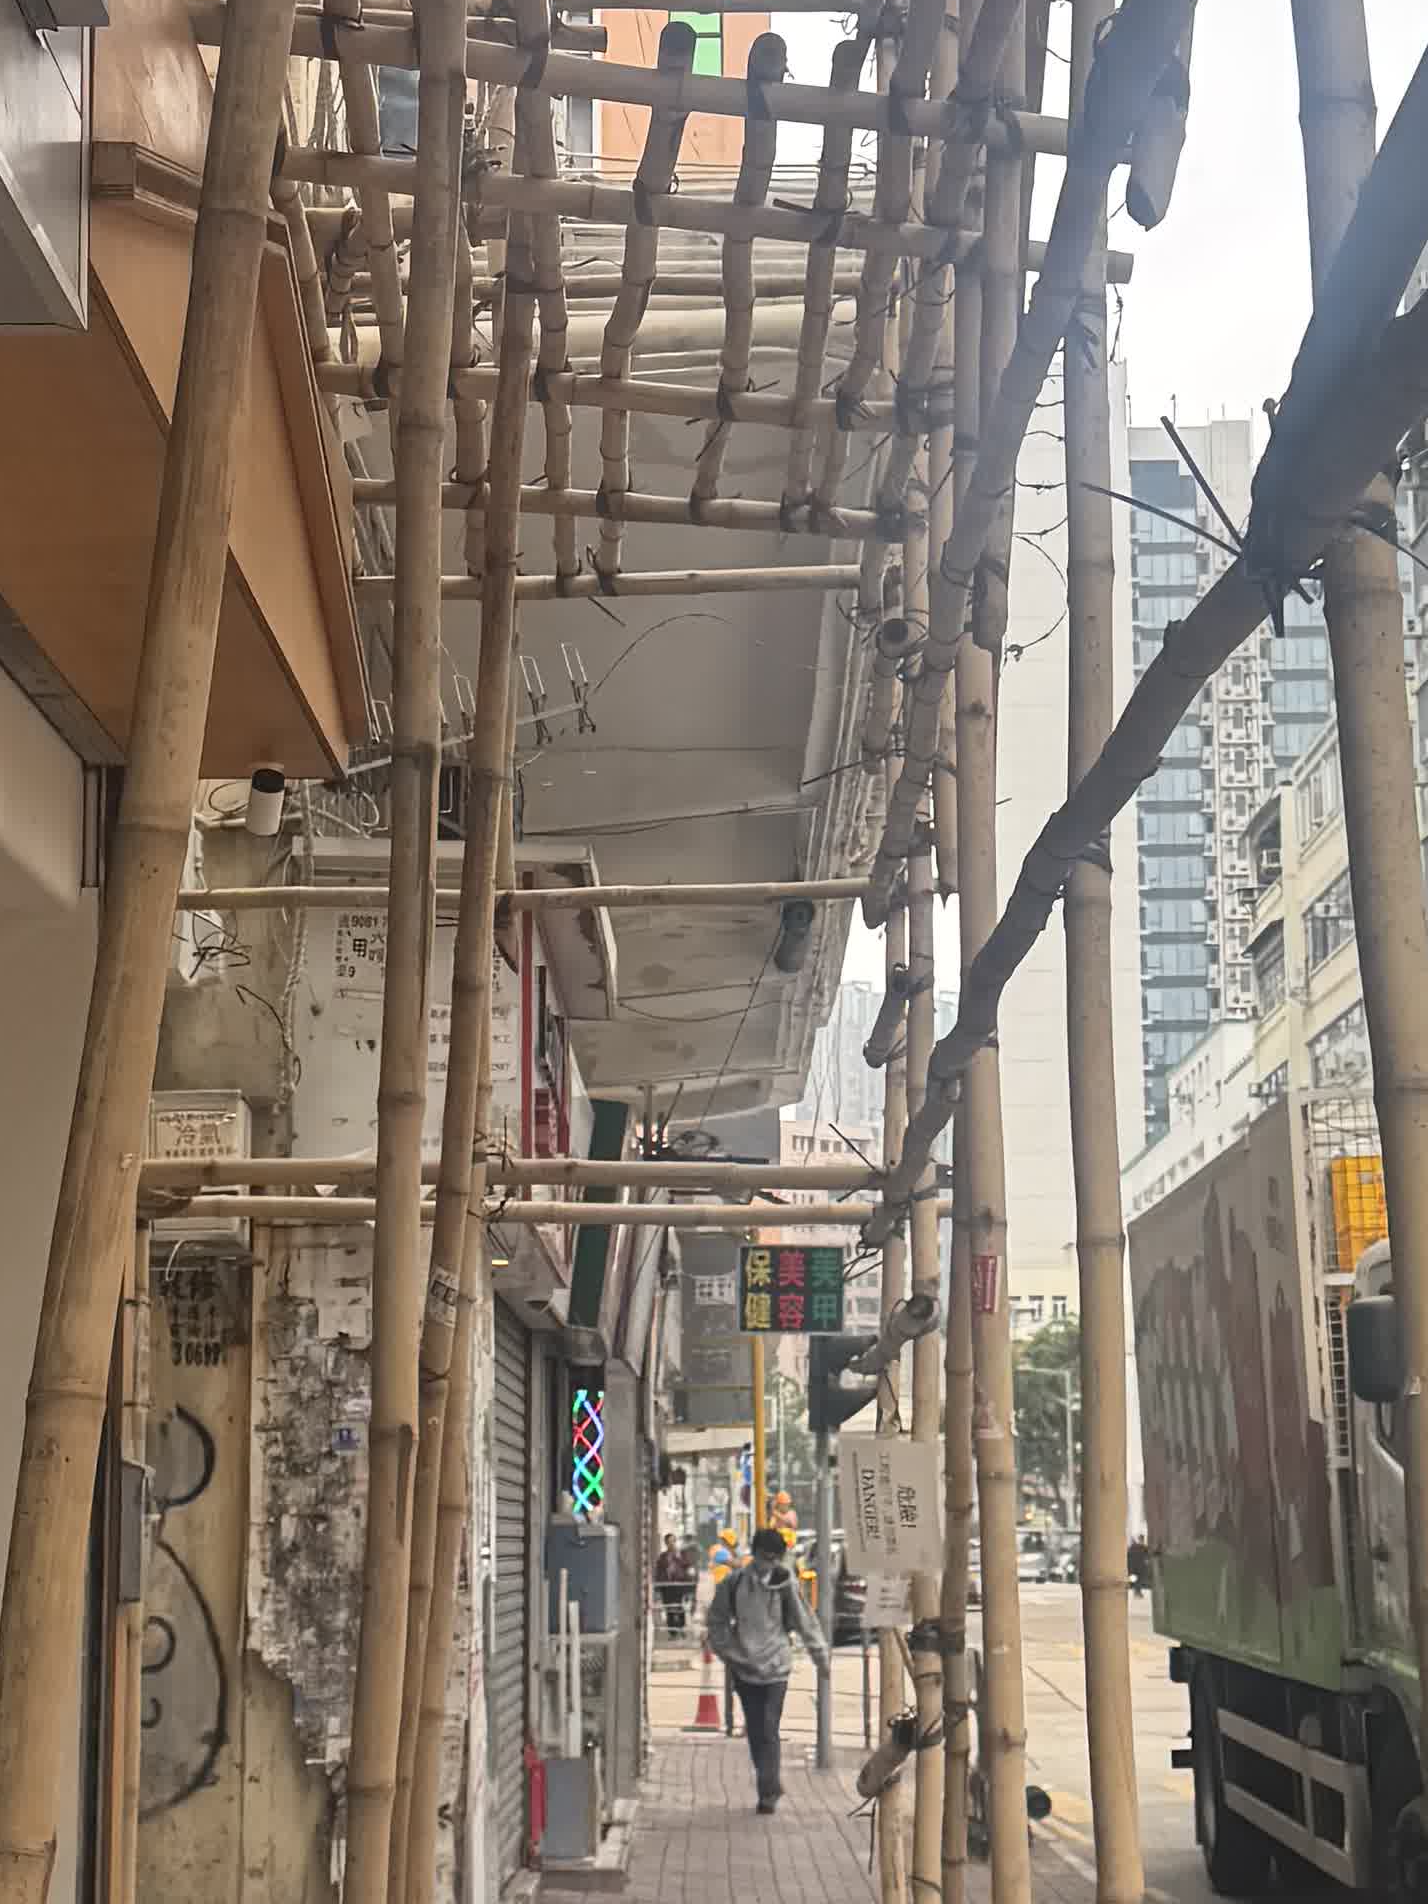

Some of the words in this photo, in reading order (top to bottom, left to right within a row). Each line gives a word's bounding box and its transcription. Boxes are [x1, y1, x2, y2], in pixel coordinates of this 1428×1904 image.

[745, 1247, 771, 1330] 保健
[779, 1247, 805, 1330] 美容
[861, 1468, 881, 1540] DANGER!
